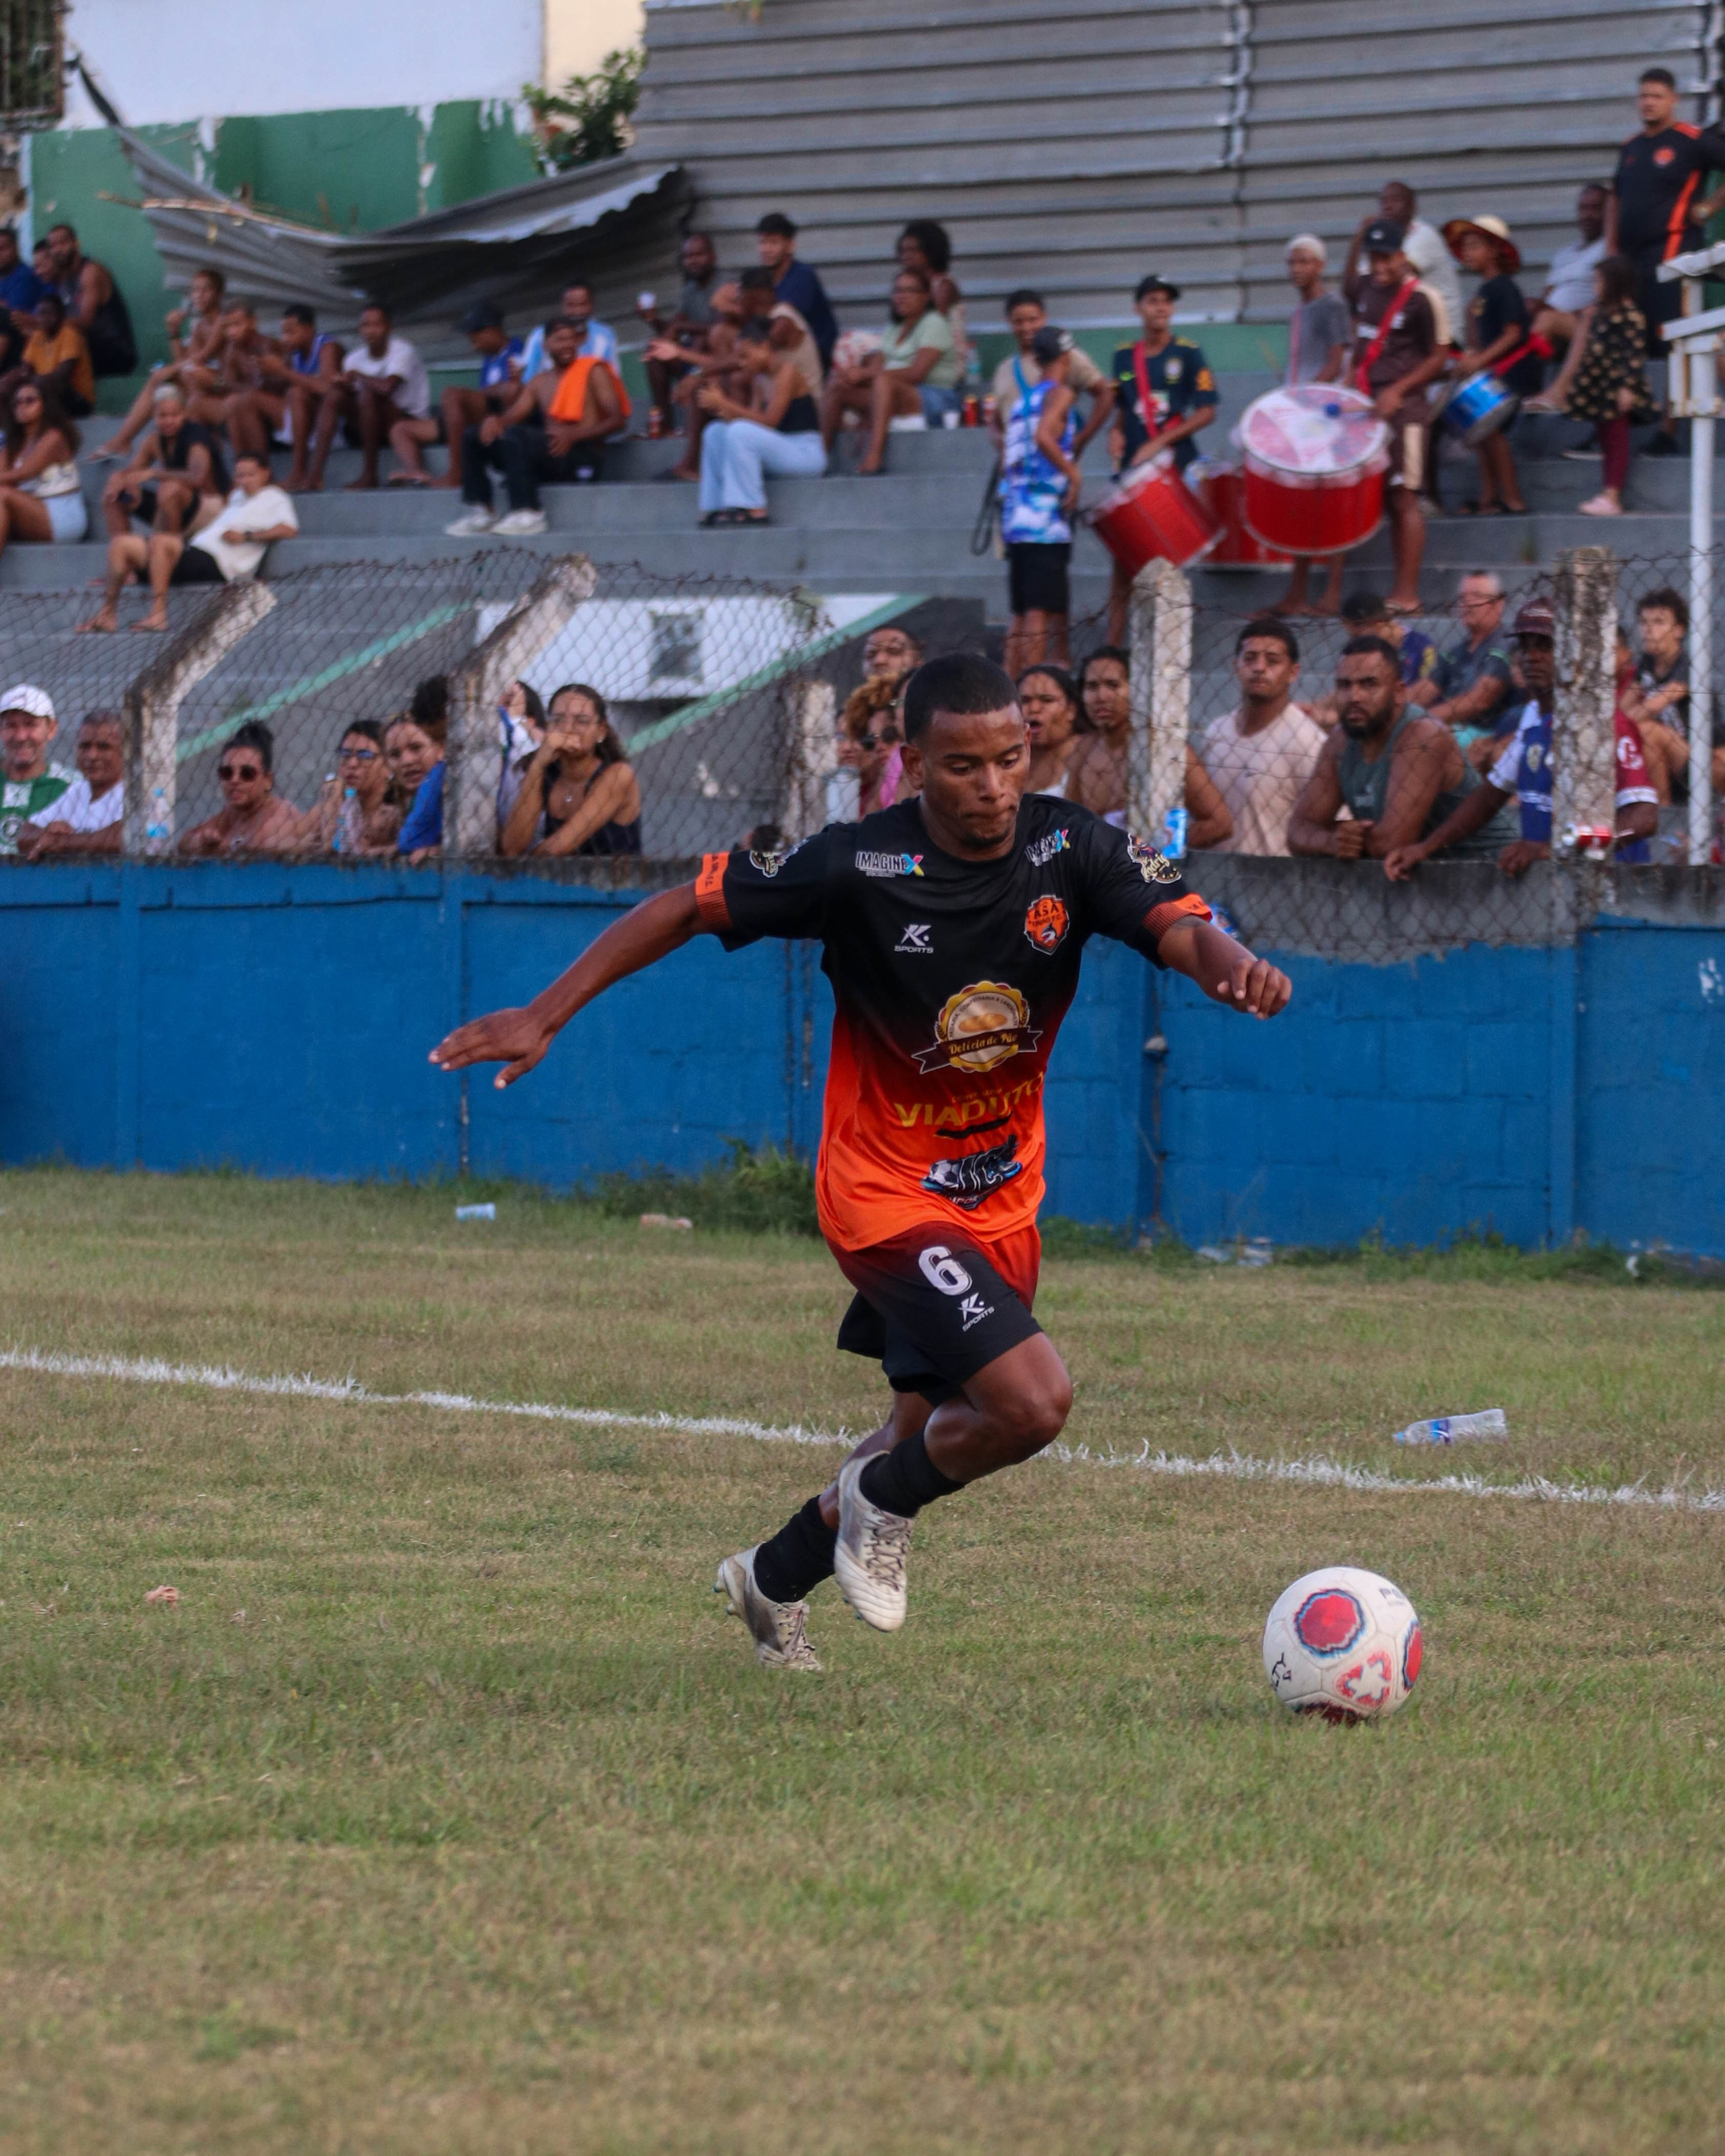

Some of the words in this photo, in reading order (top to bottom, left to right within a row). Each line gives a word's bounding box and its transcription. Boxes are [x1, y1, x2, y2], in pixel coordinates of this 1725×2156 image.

[1034, 903, 1059, 920] ASA
[894, 945, 934, 954] SPORTS
[893, 1071, 1044, 1127] VIADUTO
[918, 1246, 972, 1296] 6
[962, 1306, 995, 1332] SPORTS
